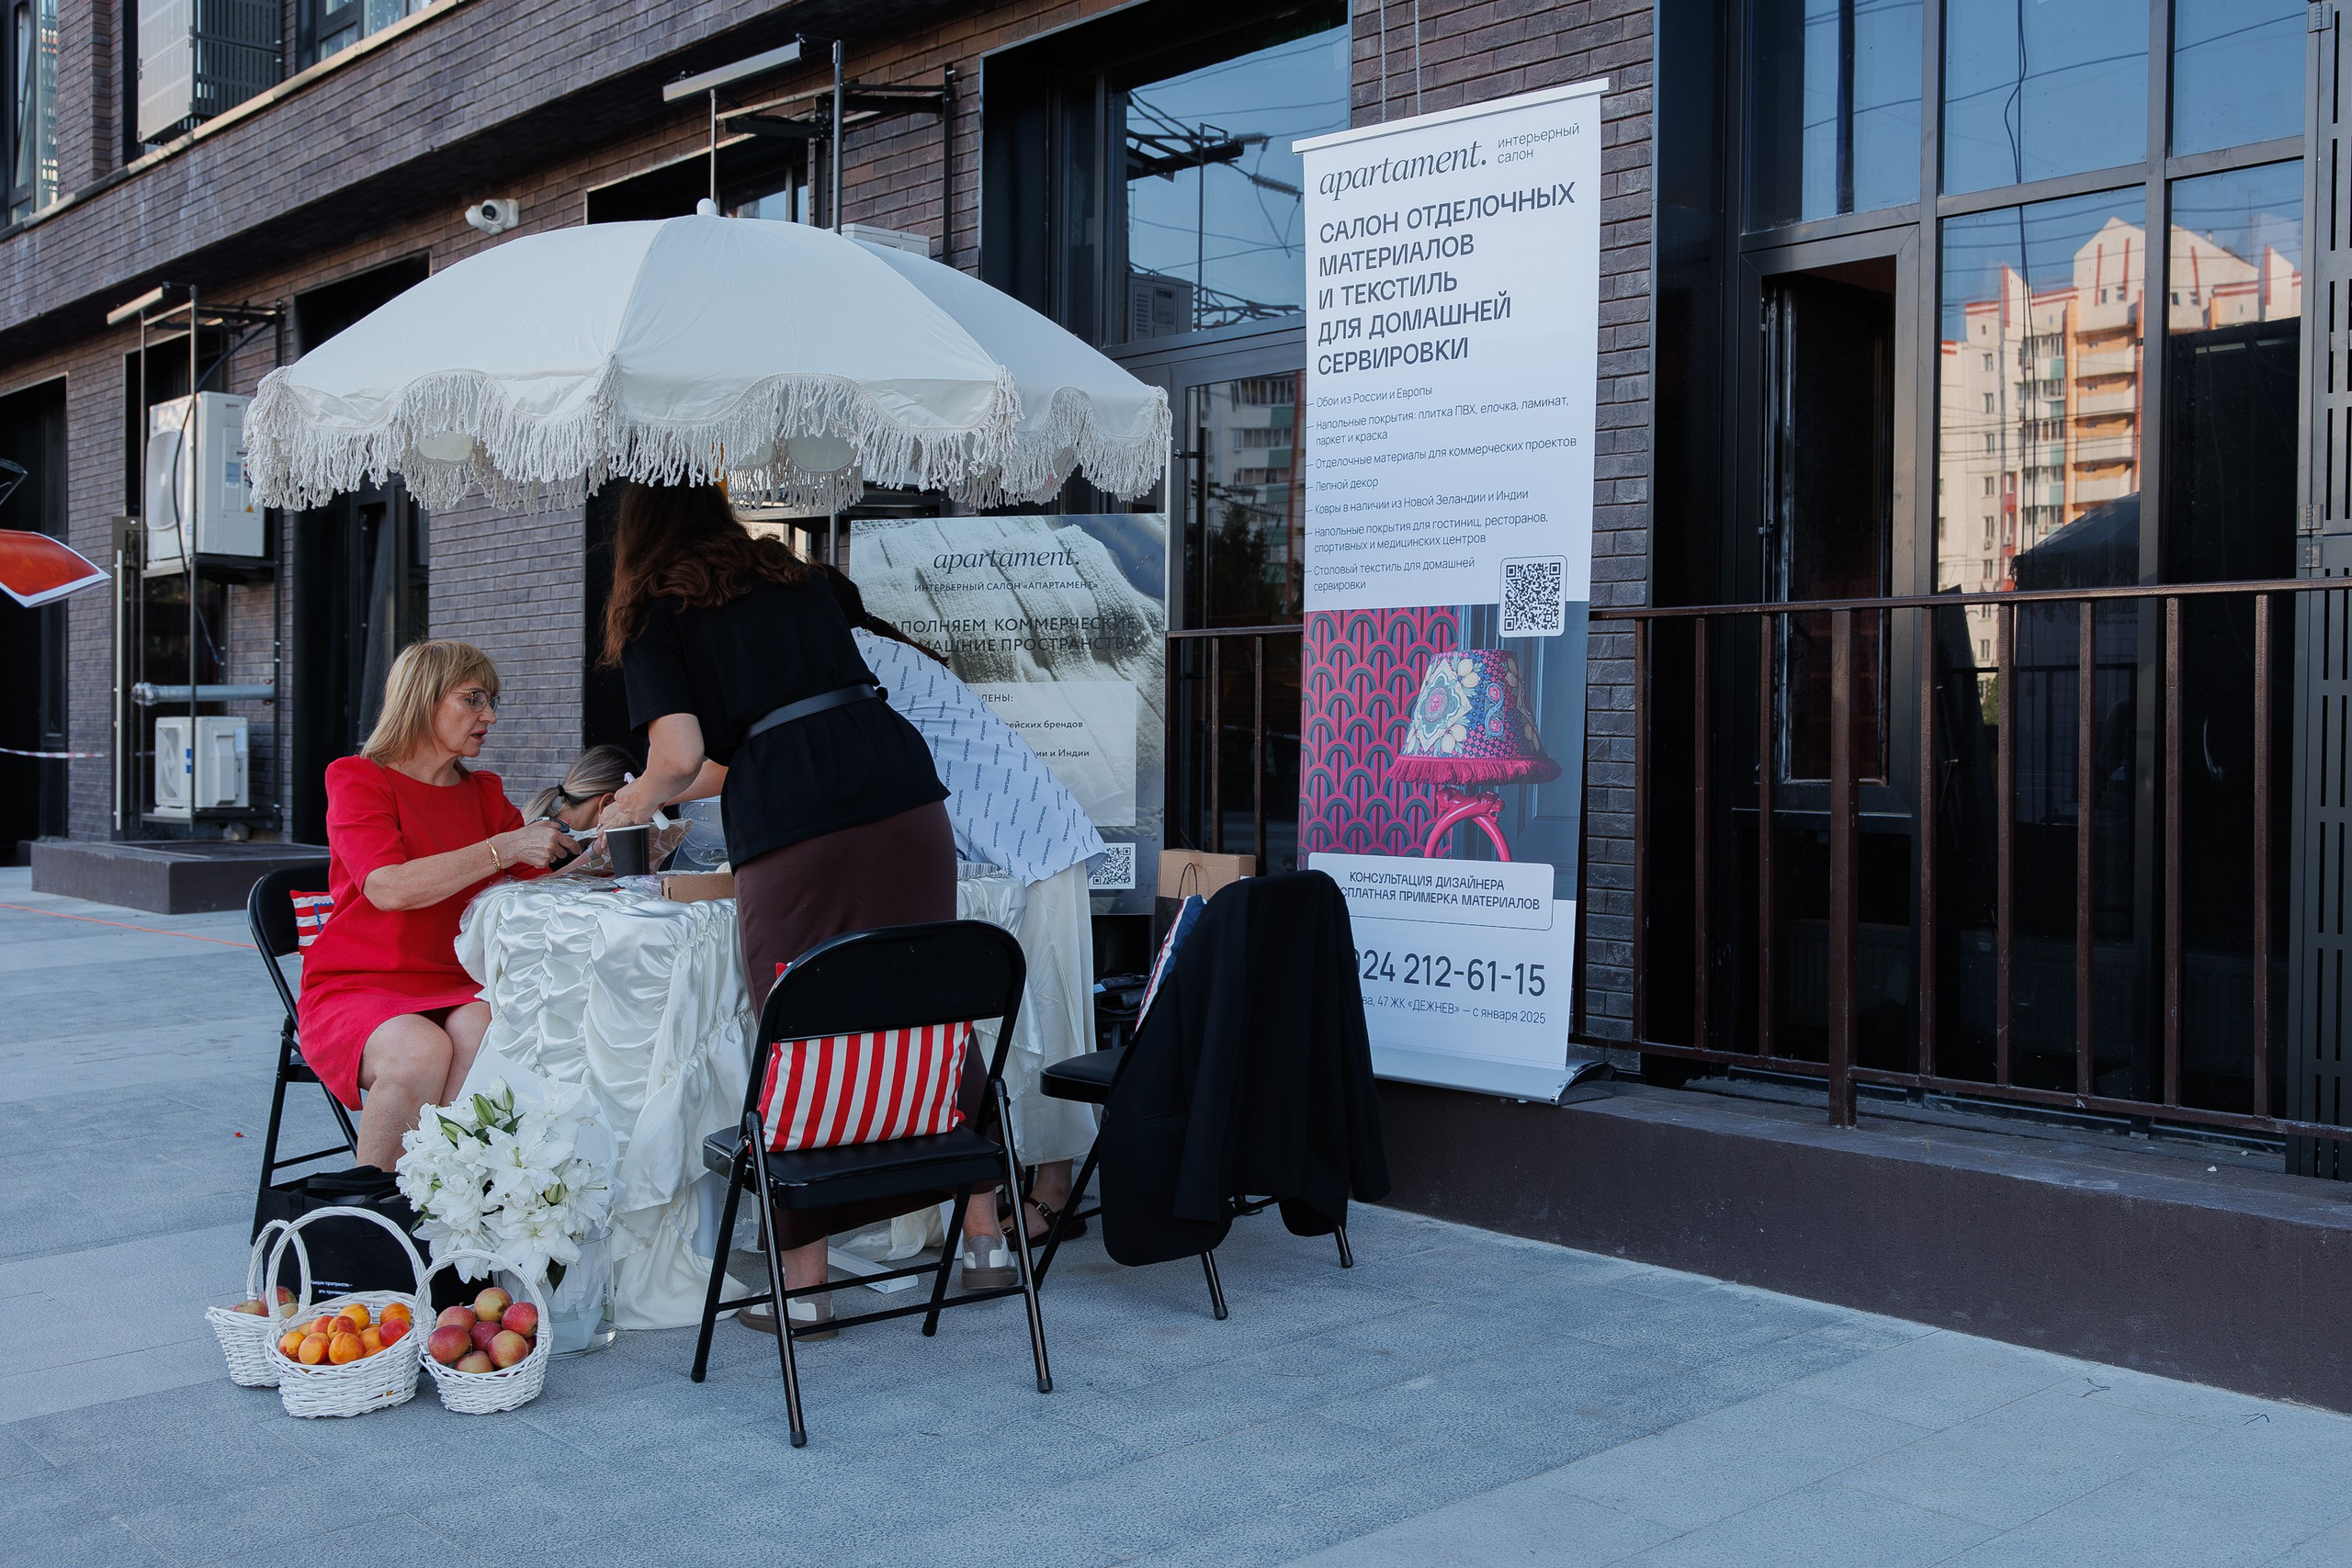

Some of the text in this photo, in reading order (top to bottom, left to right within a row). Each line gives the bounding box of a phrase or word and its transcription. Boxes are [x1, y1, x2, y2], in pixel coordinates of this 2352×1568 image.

[1498, 122, 1580, 149] интерьерный
[1497, 149, 1533, 164] салон
[1320, 140, 1487, 201] apartament.
[1320, 182, 1576, 243] САЛОН ОТДЕЛОЧНЫХ
[1319, 233, 1475, 276] МАТЕРИАЛОВ
[1318, 271, 1458, 310] И ТЕКСТИЛЬ
[1317, 290, 1511, 346] ДЛЯ ДОМАШНЕЙ
[1317, 336, 1468, 376] СЕРВИРОВКИ
[1316, 386, 1432, 408] Обои из России и Европы
[1316, 396, 1568, 430] Напольные покрытия: плитка ПВХ, елочка, ламинат,
[1316, 431, 1388, 447] паркет и краска
[1315, 437, 1577, 469] Отделочные материалы для коммерческих проектов
[1315, 478, 1379, 492] Лепной декор
[1315, 490, 1529, 516] Ковры в наличии из Новой Зеландии и Индии
[1314, 513, 1548, 537] Напольные покрытия для гостиниц, ресторанов,
[1314, 534, 1487, 555] спортивных и медицинских центров
[933, 547, 1080, 575] apartament.
[1313, 556, 1476, 576] Столовый текстиль для домашней
[914, 581, 1098, 592] ИНТЕРЬЕРНЫЙ САЛОН «АПАРТАМЕНТ»
[1313, 581, 1366, 593] сервировки
[994, 616, 1136, 632] КОММЕРЧЕСКИЕ
[1001, 637, 1137, 652] ПРОСТРАНСТВА
[981, 694, 1013, 703] ЛЕНЫ:
[1009, 720, 1042, 729] ейских
[1044, 719, 1083, 730] брендов
[1057, 749, 1090, 758] Индии
[1349, 871, 1505, 892] КОНСУЛЬТАЦИЯ ДИЗАЙНЕРА
[1340, 886, 1541, 910] СПЛАТНАЯ ПРИМЕРКА МАТЕРИАЛОВ
[1404, 953, 1545, 998] 212-61-15
[1363, 996, 1375, 1007] ва,
[1377, 996, 1389, 1007] 47
[1390, 997, 1406, 1009] ЖК
[1407, 998, 1460, 1014] «ДЕЖНЕВ»
[1472, 1008, 1478, 1017] с
[1480, 1009, 1518, 1023] января
[1520, 1010, 1546, 1024] 2025
